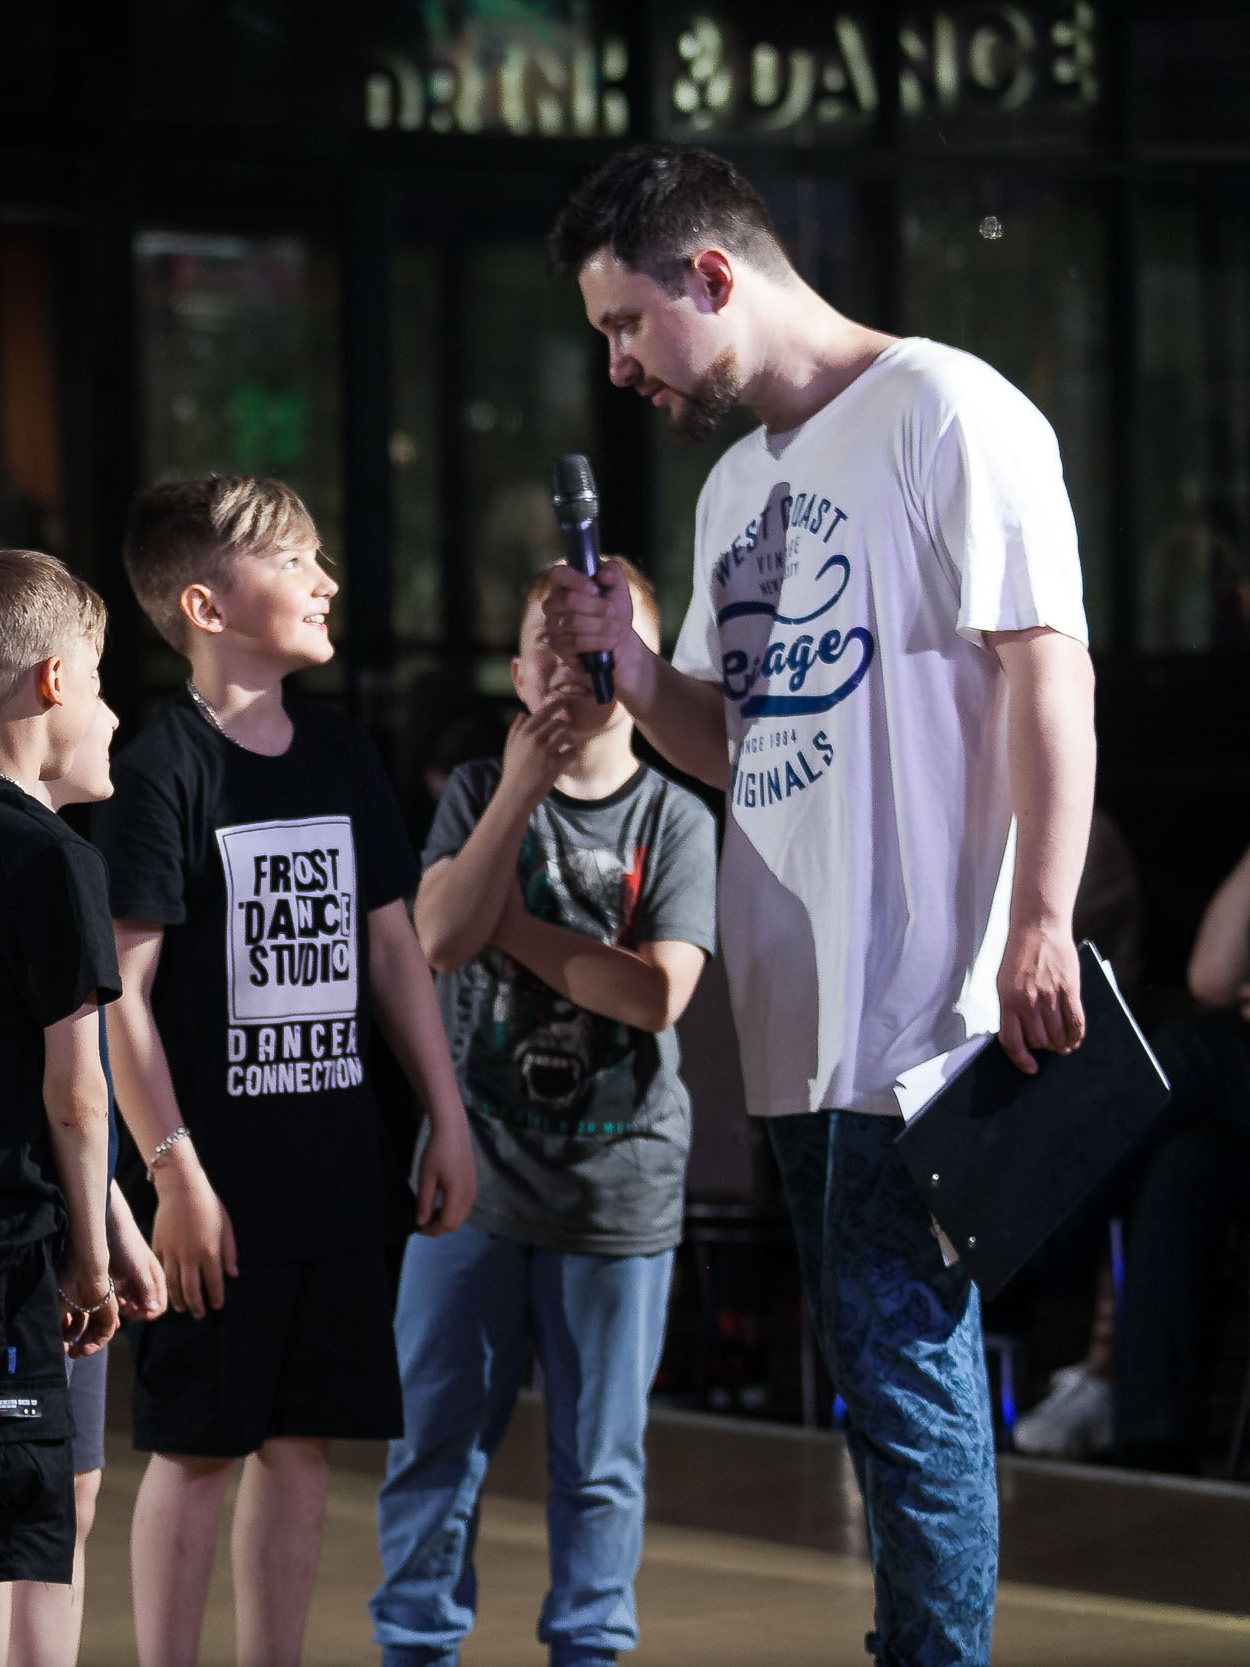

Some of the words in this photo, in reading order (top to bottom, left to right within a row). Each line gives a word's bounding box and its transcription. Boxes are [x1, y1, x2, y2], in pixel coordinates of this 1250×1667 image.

[751, 2, 1100, 130] DANCE
[715, 504, 770, 588] WEST
[781, 492, 849, 543] COAST
[253, 848, 340, 897] FROST
[244, 892, 351, 946] DANCE
[250, 940, 350, 987] STUDIO
[227, 1056, 364, 1097] CONNECTION
